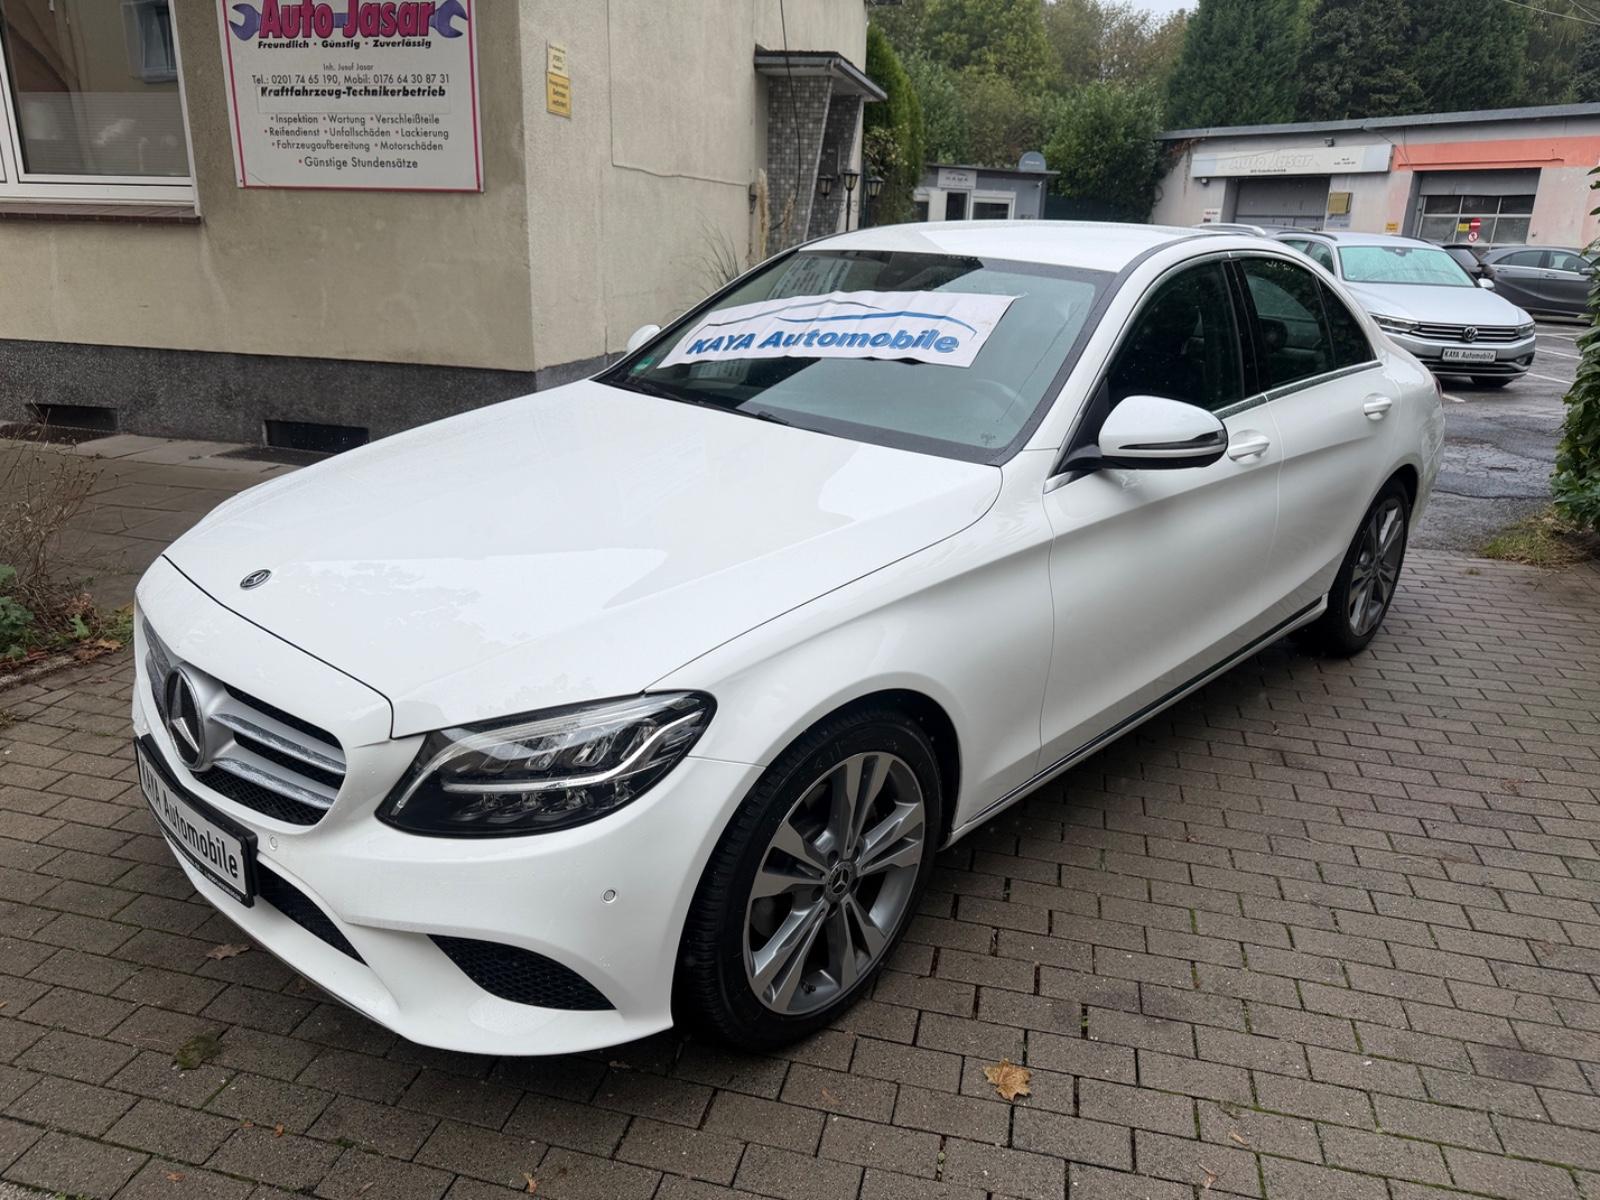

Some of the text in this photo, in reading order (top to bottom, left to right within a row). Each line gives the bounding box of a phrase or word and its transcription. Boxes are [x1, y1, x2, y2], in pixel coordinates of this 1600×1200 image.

[258, 0, 435, 39] Auto Jasar
[258, 39, 431, 50] Freundlich Günstig Zuverlässig
[252, 73, 449, 85] Tel.: 0201 74 65 190, Mobil: 0176 64 30 87 31
[260, 85, 446, 99] Kraftfahrzeug-Technikerbetrieb
[275, 113, 440, 126] Inspektion Wartung Verschleißteile
[269, 127, 449, 140] Reifendienst Unfallschäden Lackierung
[276, 139, 444, 152] Fahrzeugaufbereitung Motorschäden
[304, 156, 419, 170] Günstige Stundensätze
[686, 329, 960, 355] KAYA Automobile
[163, 789, 238, 879] Automobile
